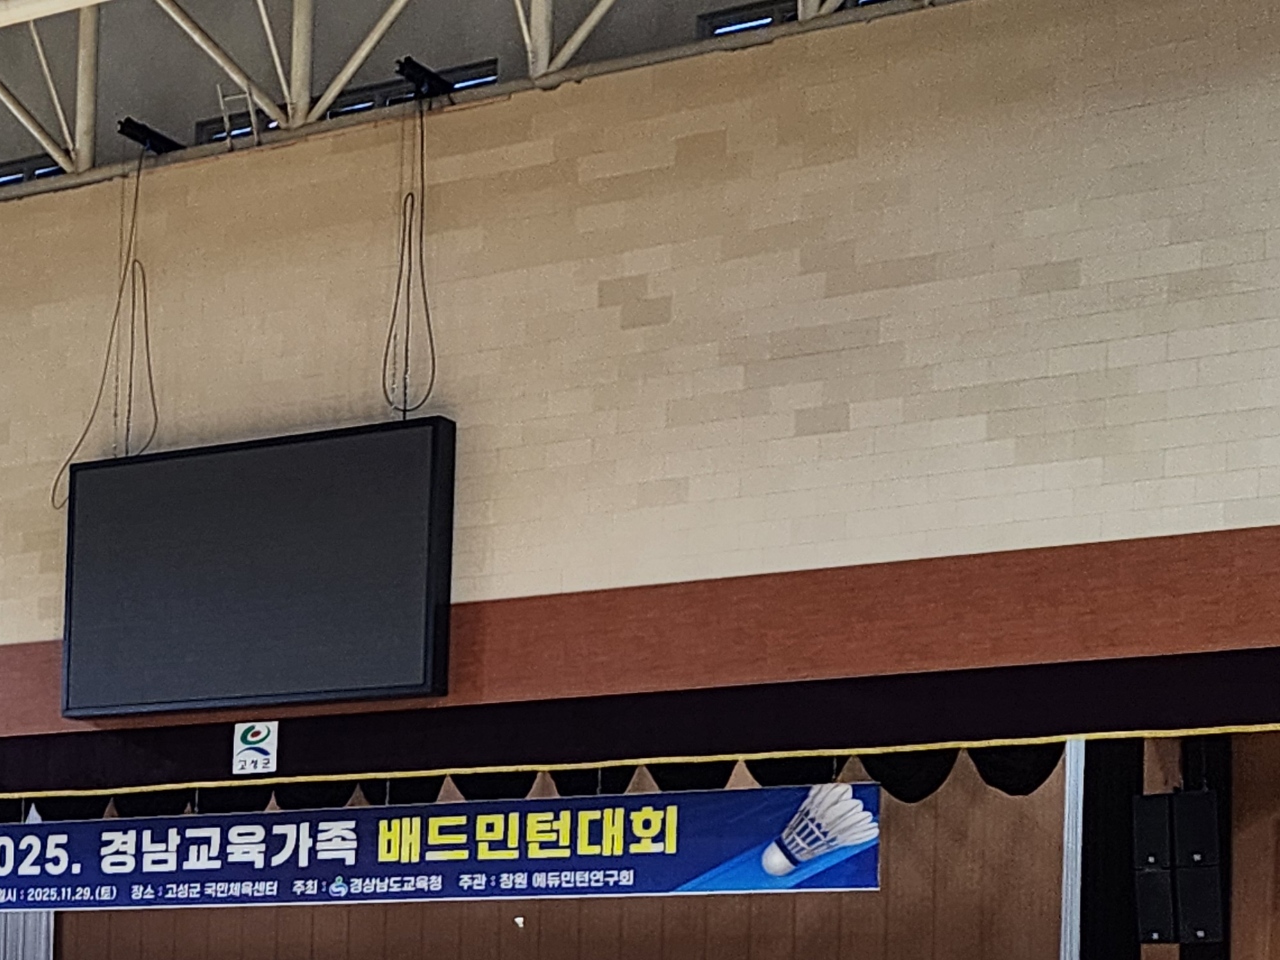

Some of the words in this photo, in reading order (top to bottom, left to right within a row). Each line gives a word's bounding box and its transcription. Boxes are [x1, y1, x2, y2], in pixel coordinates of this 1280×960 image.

[100, 821, 358, 873] 경남교육가족
[377, 806, 678, 863] 배드민턴대회
[164, 883, 201, 899] 고성군
[204, 881, 278, 898] 국민체육센터
[349, 875, 442, 894] 경상남도교육청
[532, 870, 635, 888] 에듀민턴연구회
